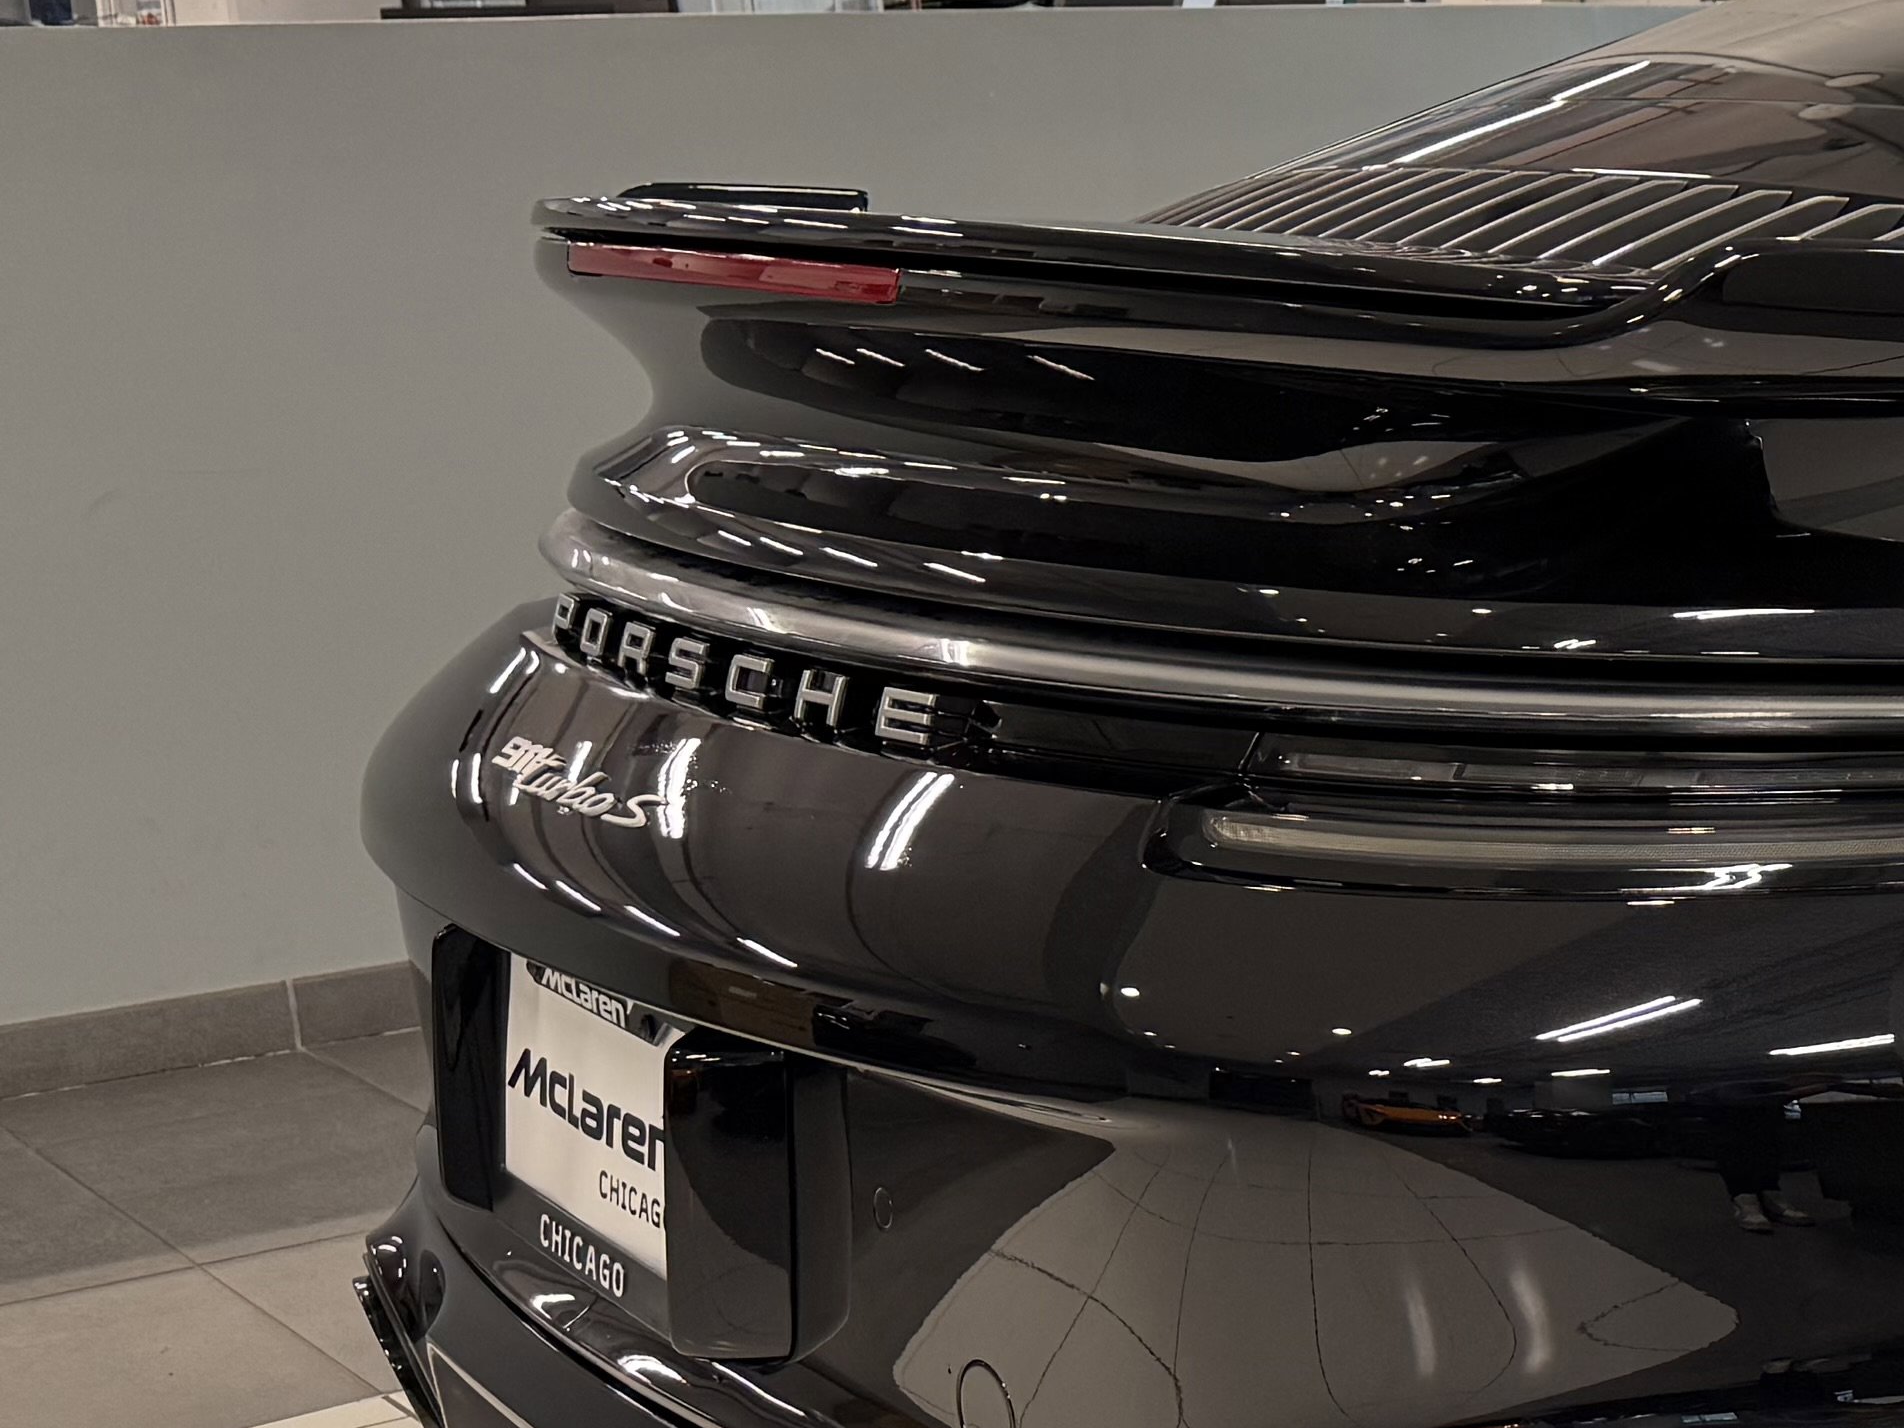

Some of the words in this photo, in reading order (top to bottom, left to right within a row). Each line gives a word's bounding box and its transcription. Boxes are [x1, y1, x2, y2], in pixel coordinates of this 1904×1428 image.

[551, 591, 941, 747] PORSCHE
[541, 967, 627, 1029] McLaren
[539, 1213, 626, 1299] CHICAGO
